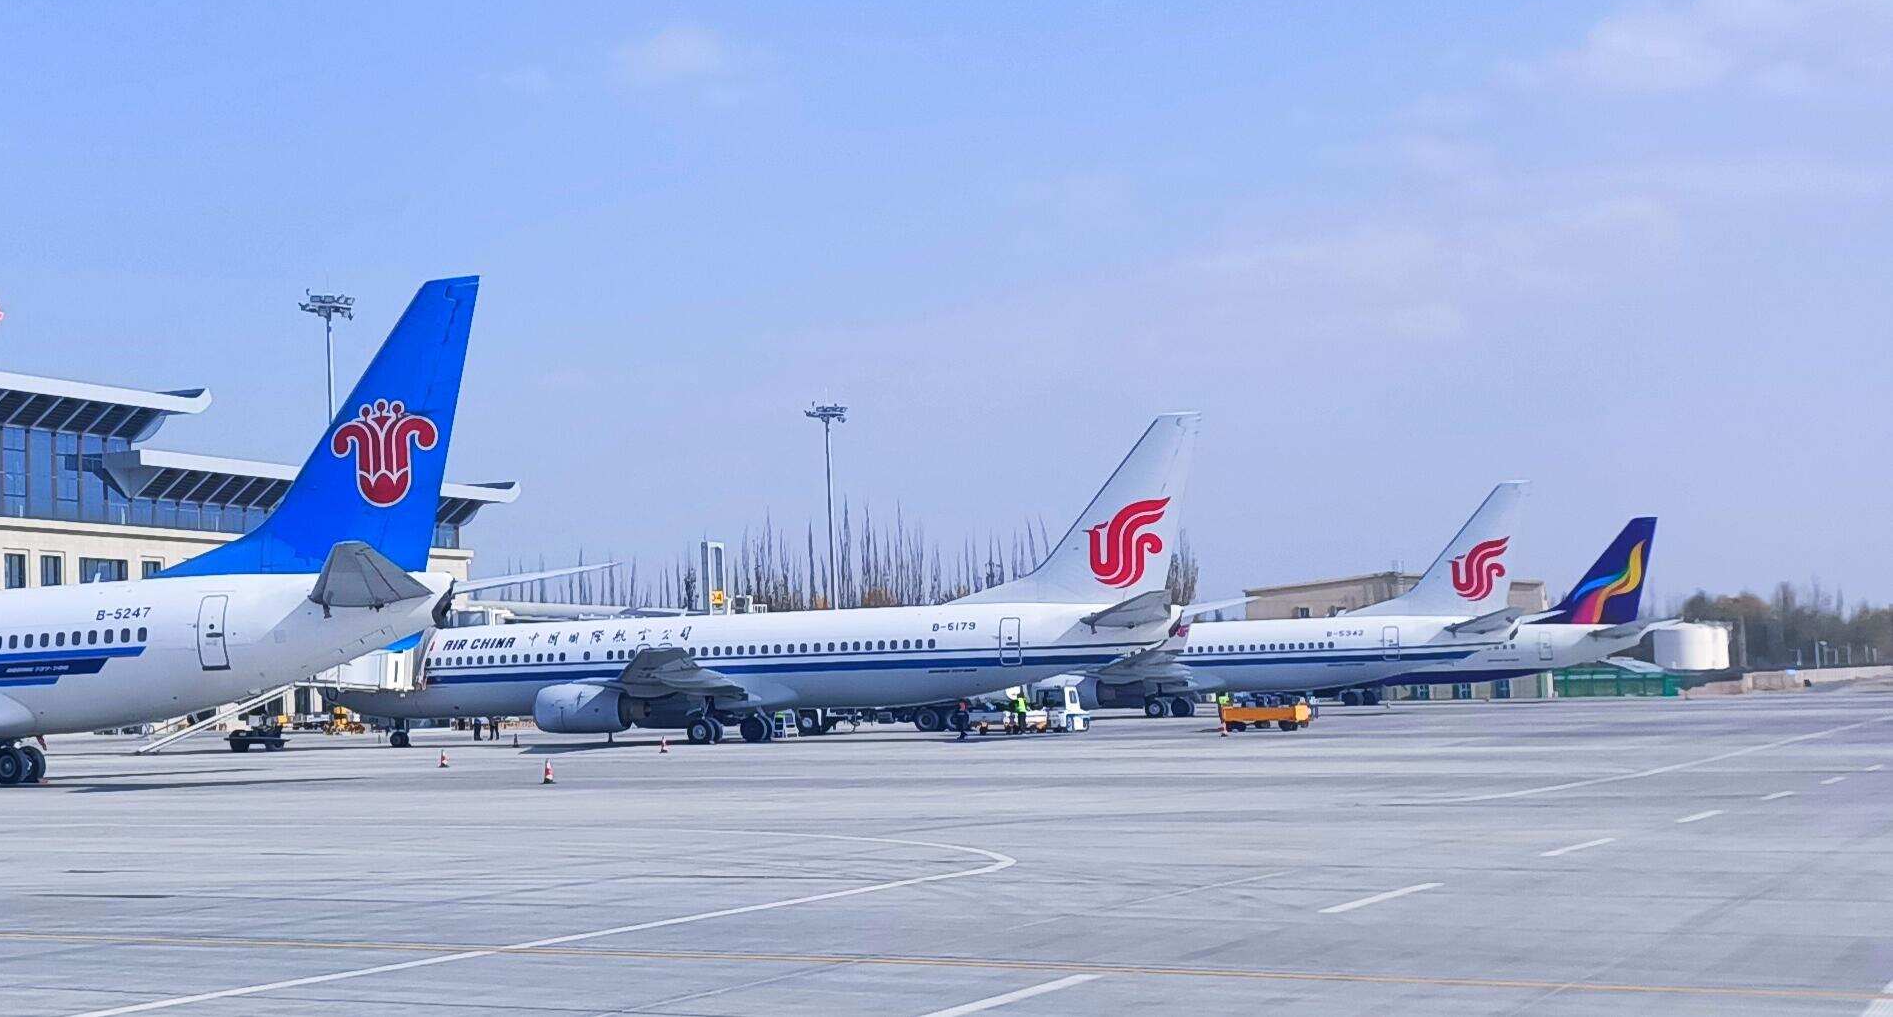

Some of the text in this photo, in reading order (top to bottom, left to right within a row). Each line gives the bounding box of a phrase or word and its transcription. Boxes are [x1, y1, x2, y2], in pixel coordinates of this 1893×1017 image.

[95, 606, 152, 621] B-5247
[442, 636, 517, 651] AIR CHINA
